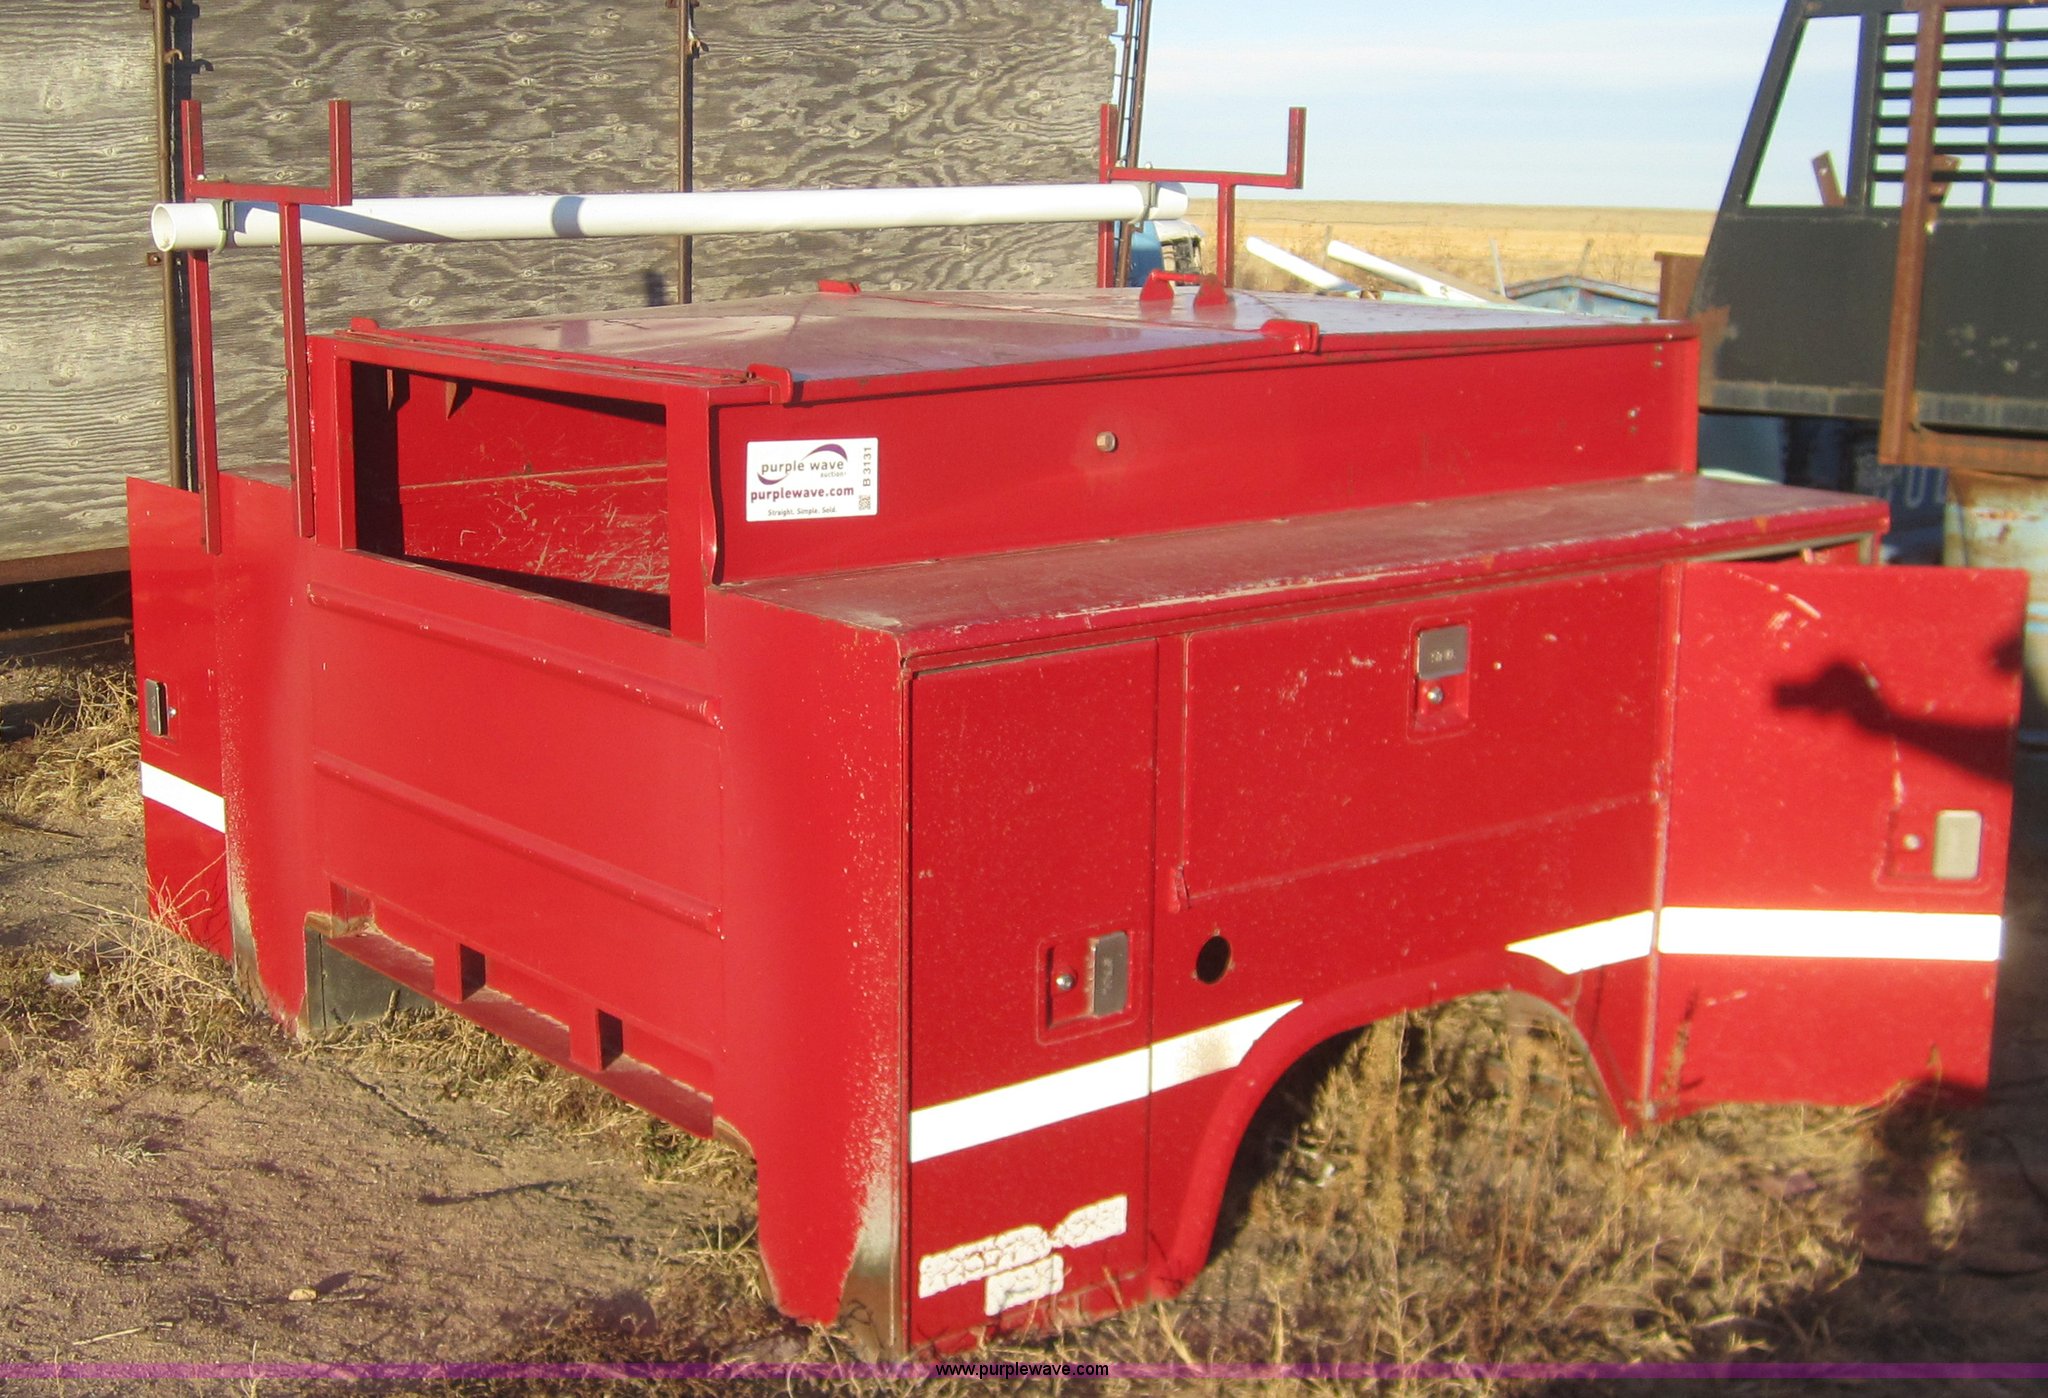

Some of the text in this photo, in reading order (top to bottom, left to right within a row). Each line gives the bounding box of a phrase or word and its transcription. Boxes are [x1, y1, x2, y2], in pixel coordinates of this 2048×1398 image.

[761, 460, 844, 475] purple wave
[863, 447, 871, 487] B 3131
[751, 487, 854, 503] purplewave.com
[768, 506, 837, 517] Straight. Simple. Sold.
